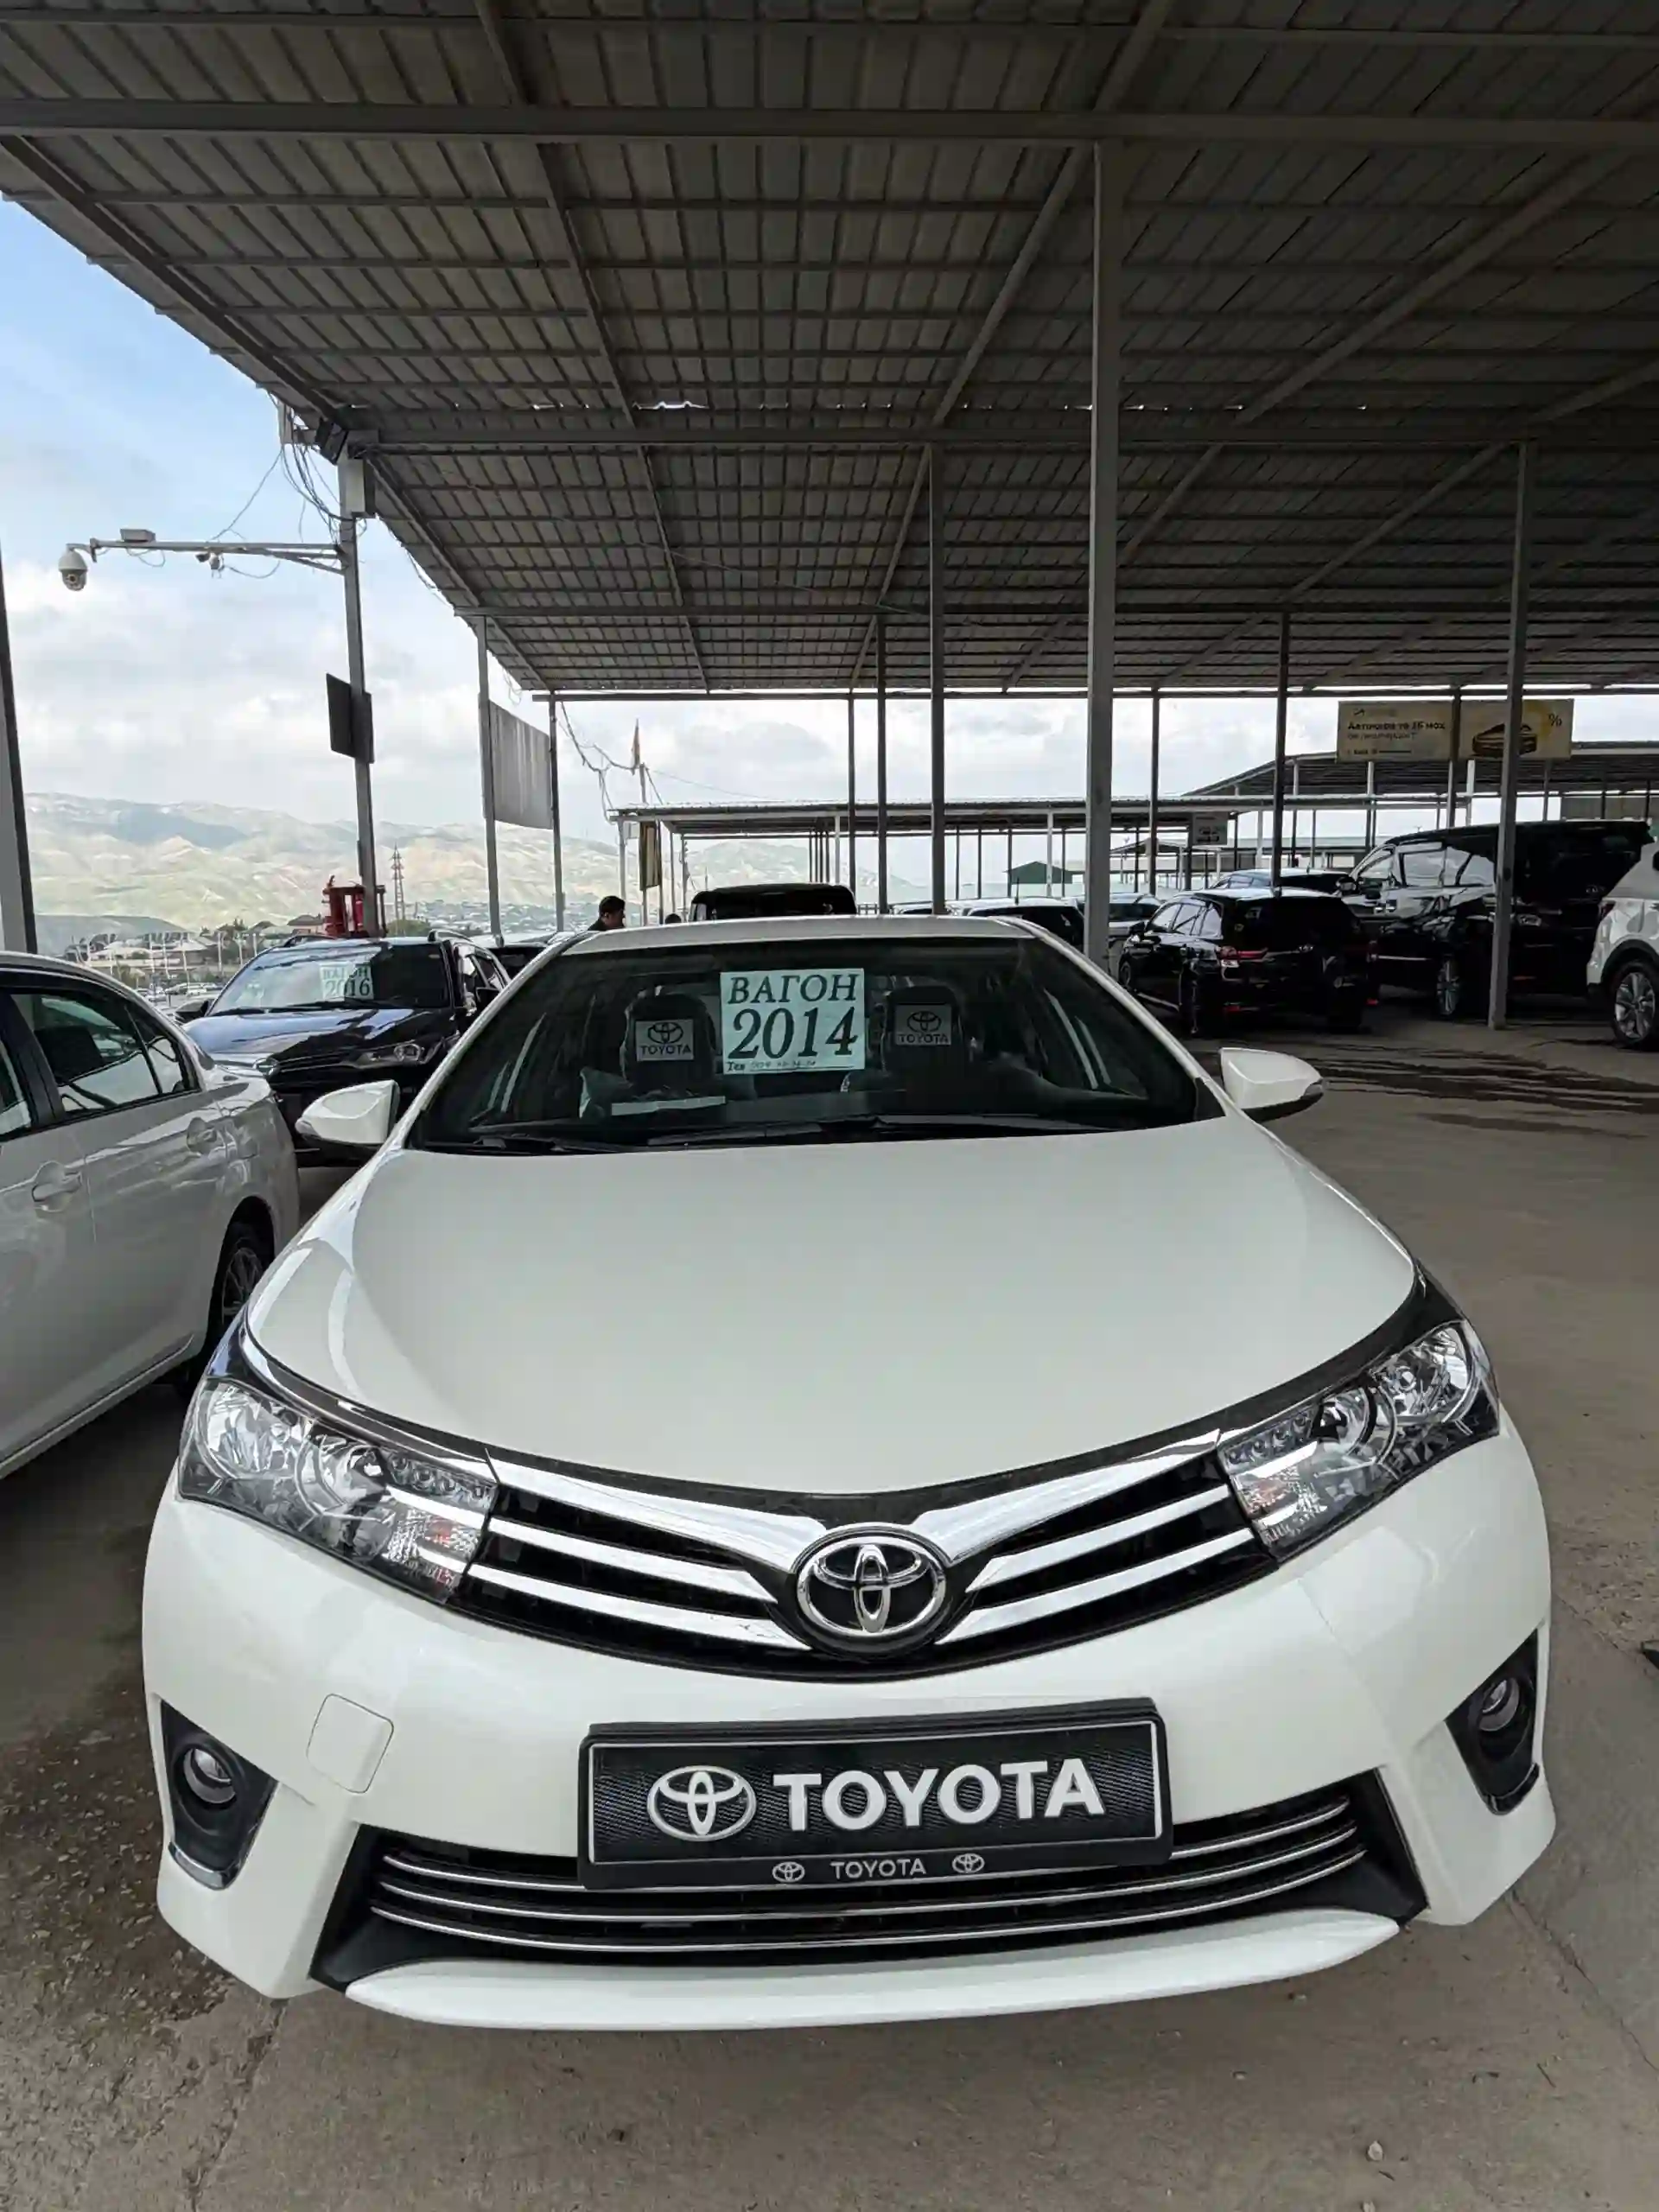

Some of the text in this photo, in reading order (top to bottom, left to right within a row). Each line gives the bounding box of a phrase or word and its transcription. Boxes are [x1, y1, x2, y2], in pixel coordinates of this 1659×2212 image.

[325, 978, 371, 997] 2016
[728, 973, 859, 1005] ВАГОН
[728, 1006, 859, 1059] 2014
[899, 1033, 950, 1045] TOYOTA
[640, 1044, 692, 1056] TOYOTA
[772, 1758, 1106, 1832] TOYOTA
[829, 1857, 927, 1880] TOYOTA
